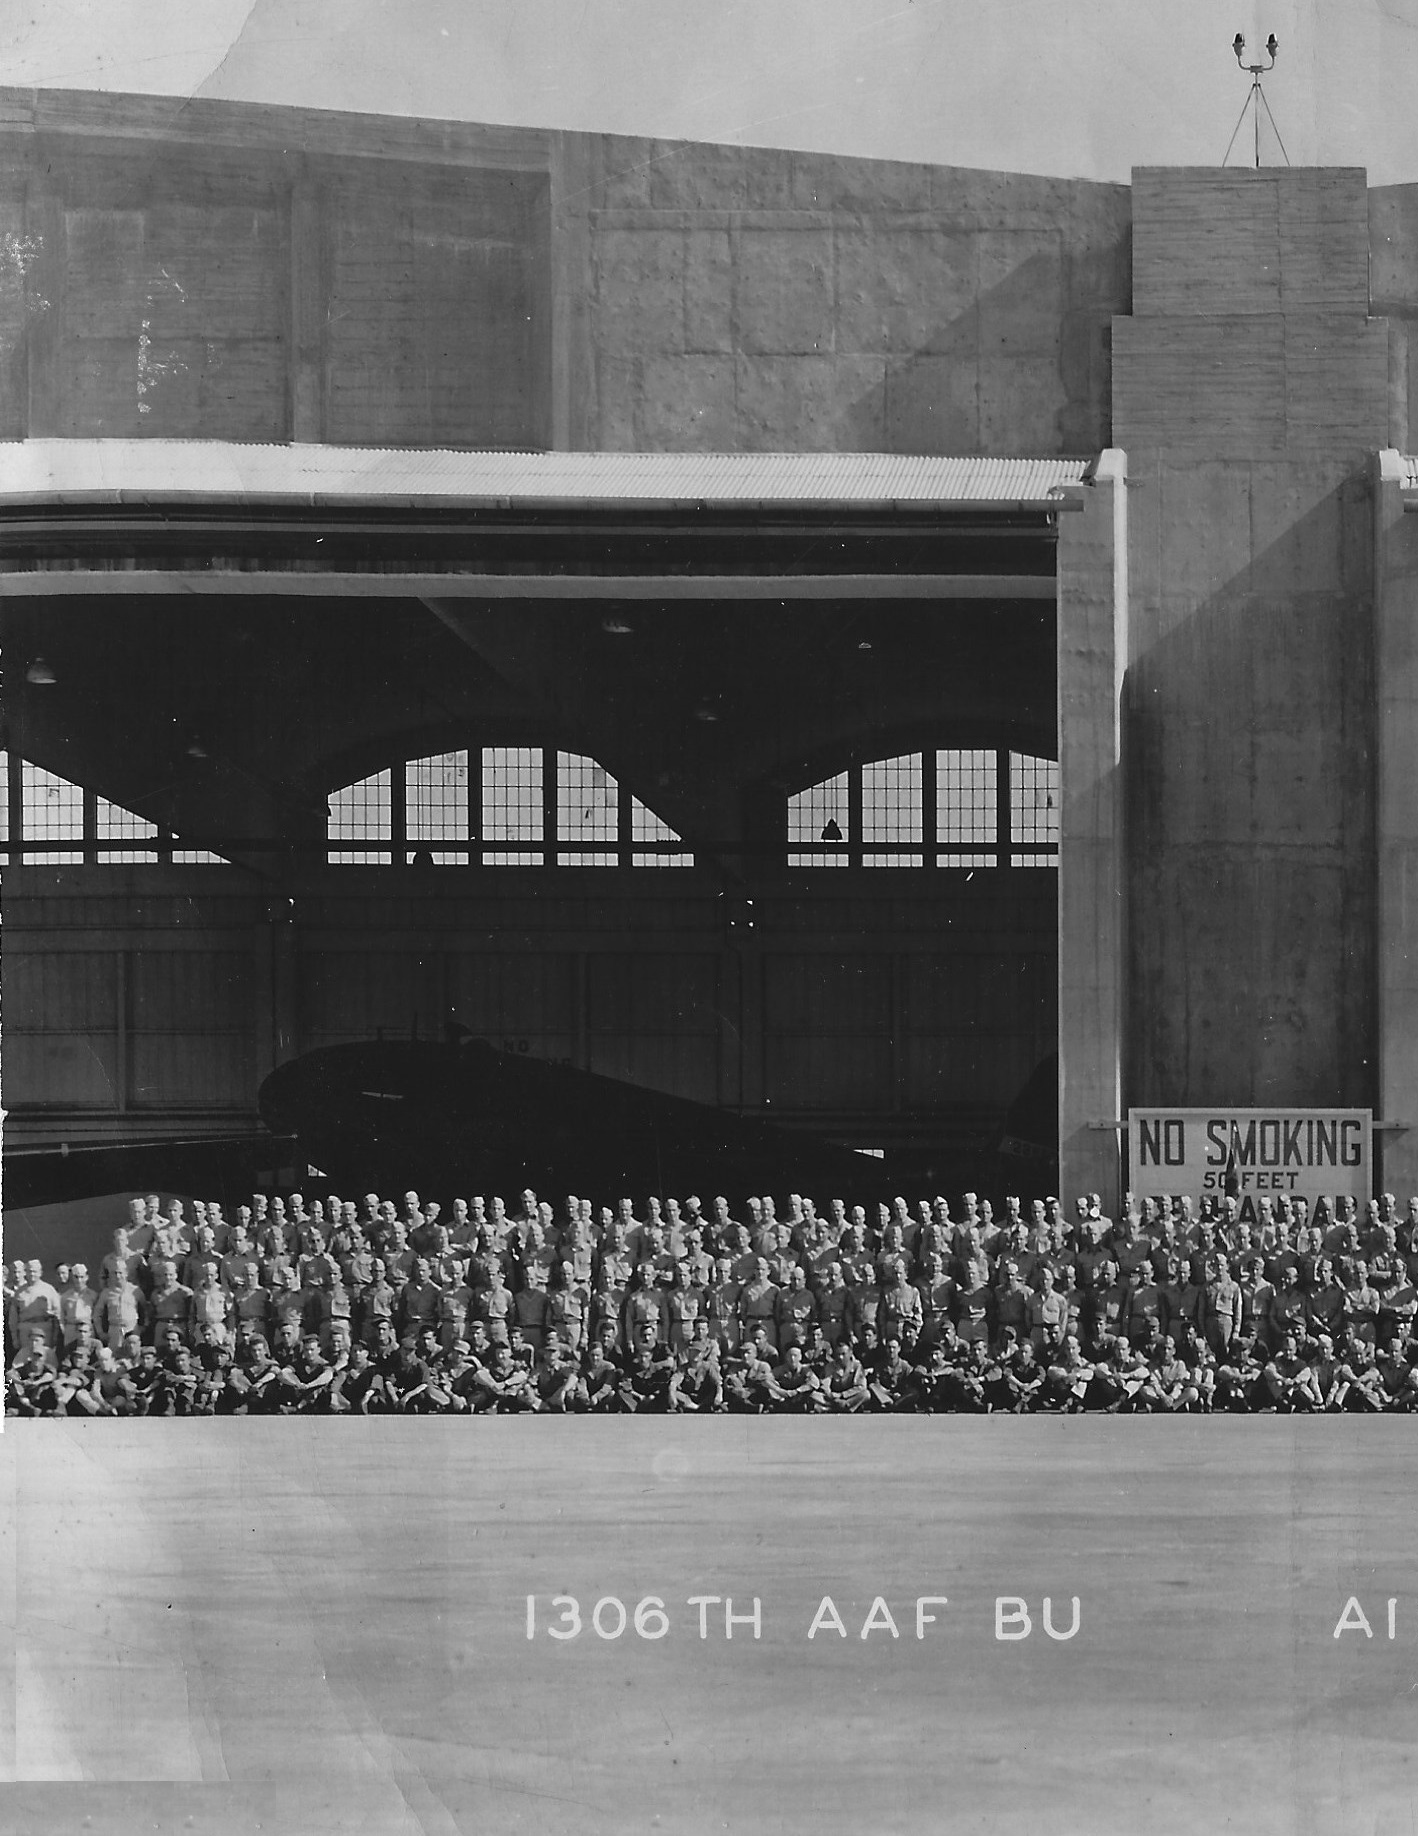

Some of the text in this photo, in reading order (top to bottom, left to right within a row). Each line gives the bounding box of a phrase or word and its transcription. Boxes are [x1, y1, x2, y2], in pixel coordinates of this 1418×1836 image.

[1140, 1119, 1362, 1166] NO SMOKING
[1242, 1171, 1299, 1189] FEET
